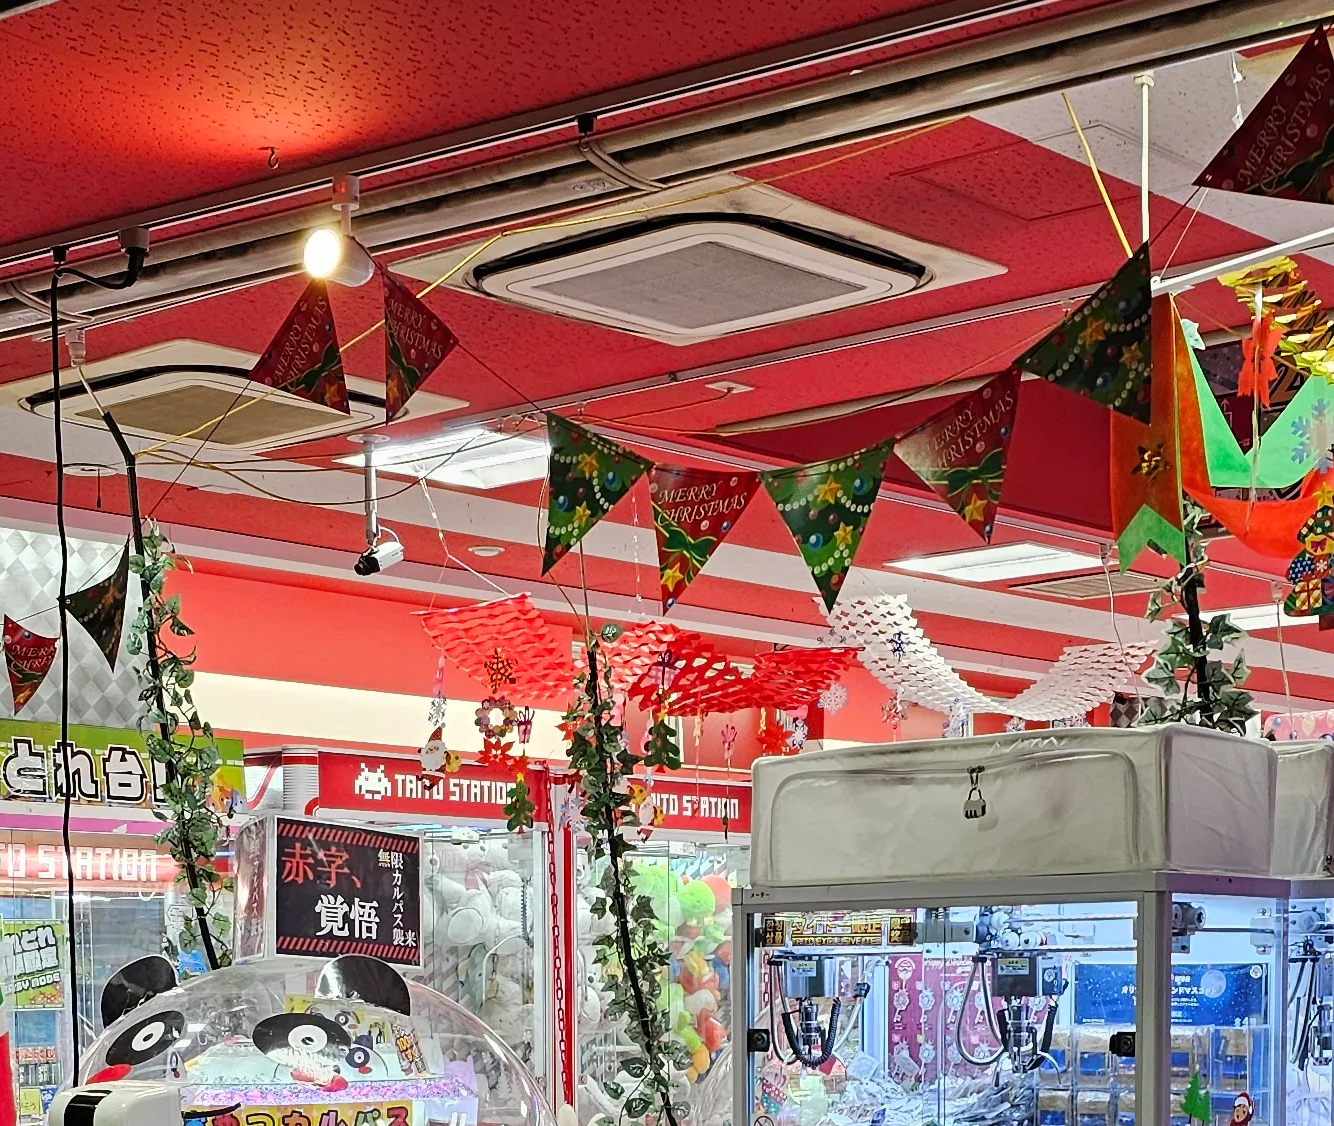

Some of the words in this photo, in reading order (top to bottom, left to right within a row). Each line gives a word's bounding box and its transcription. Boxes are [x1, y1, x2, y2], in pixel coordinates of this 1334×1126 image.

[928, 402, 975, 454] ERRY
[281, 842, 362, 889] 赤字、
[314, 894, 380, 940] 覚悟
